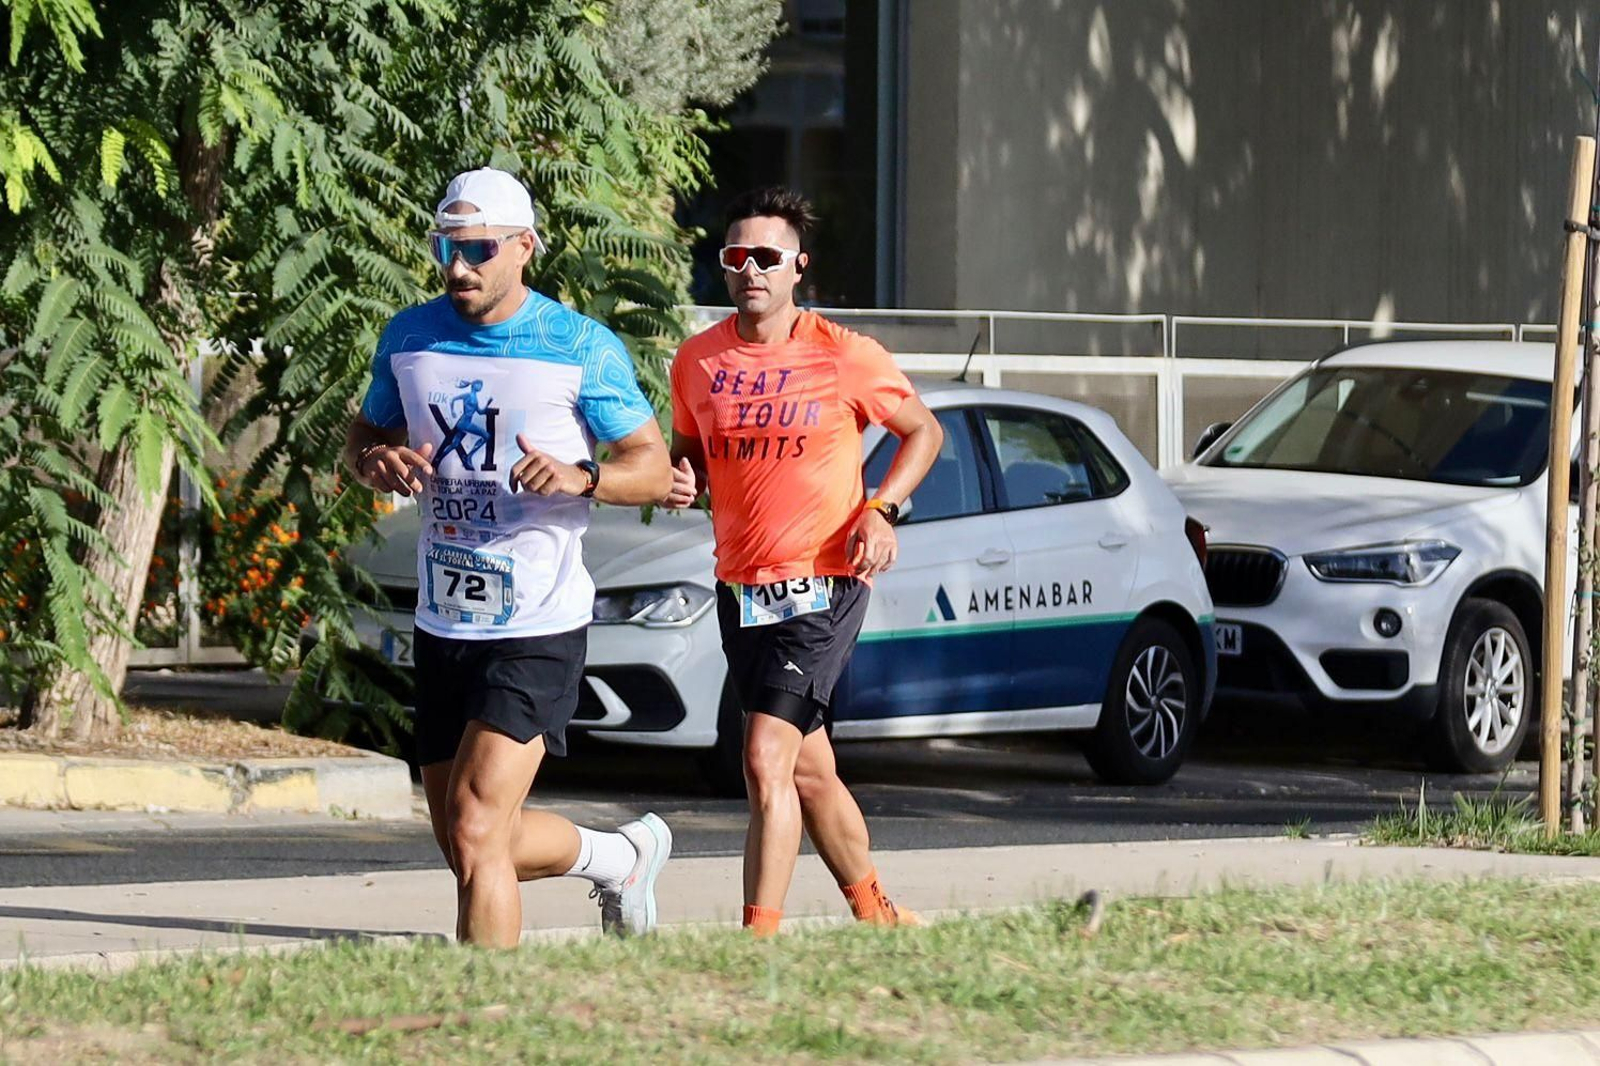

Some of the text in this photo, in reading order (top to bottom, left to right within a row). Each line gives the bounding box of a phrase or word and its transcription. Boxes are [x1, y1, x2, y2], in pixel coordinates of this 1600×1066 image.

[710, 369, 792, 396] BEAT
[736, 401, 821, 428] YOUR
[428, 403, 500, 475] XI
[708, 435, 807, 461] LIMITS
[464, 479, 497, 488] URBANA
[432, 497, 497, 522] 2024
[443, 569, 487, 602] 72
[755, 576, 811, 606] 103
[967, 579, 1093, 614] AMENABAR
